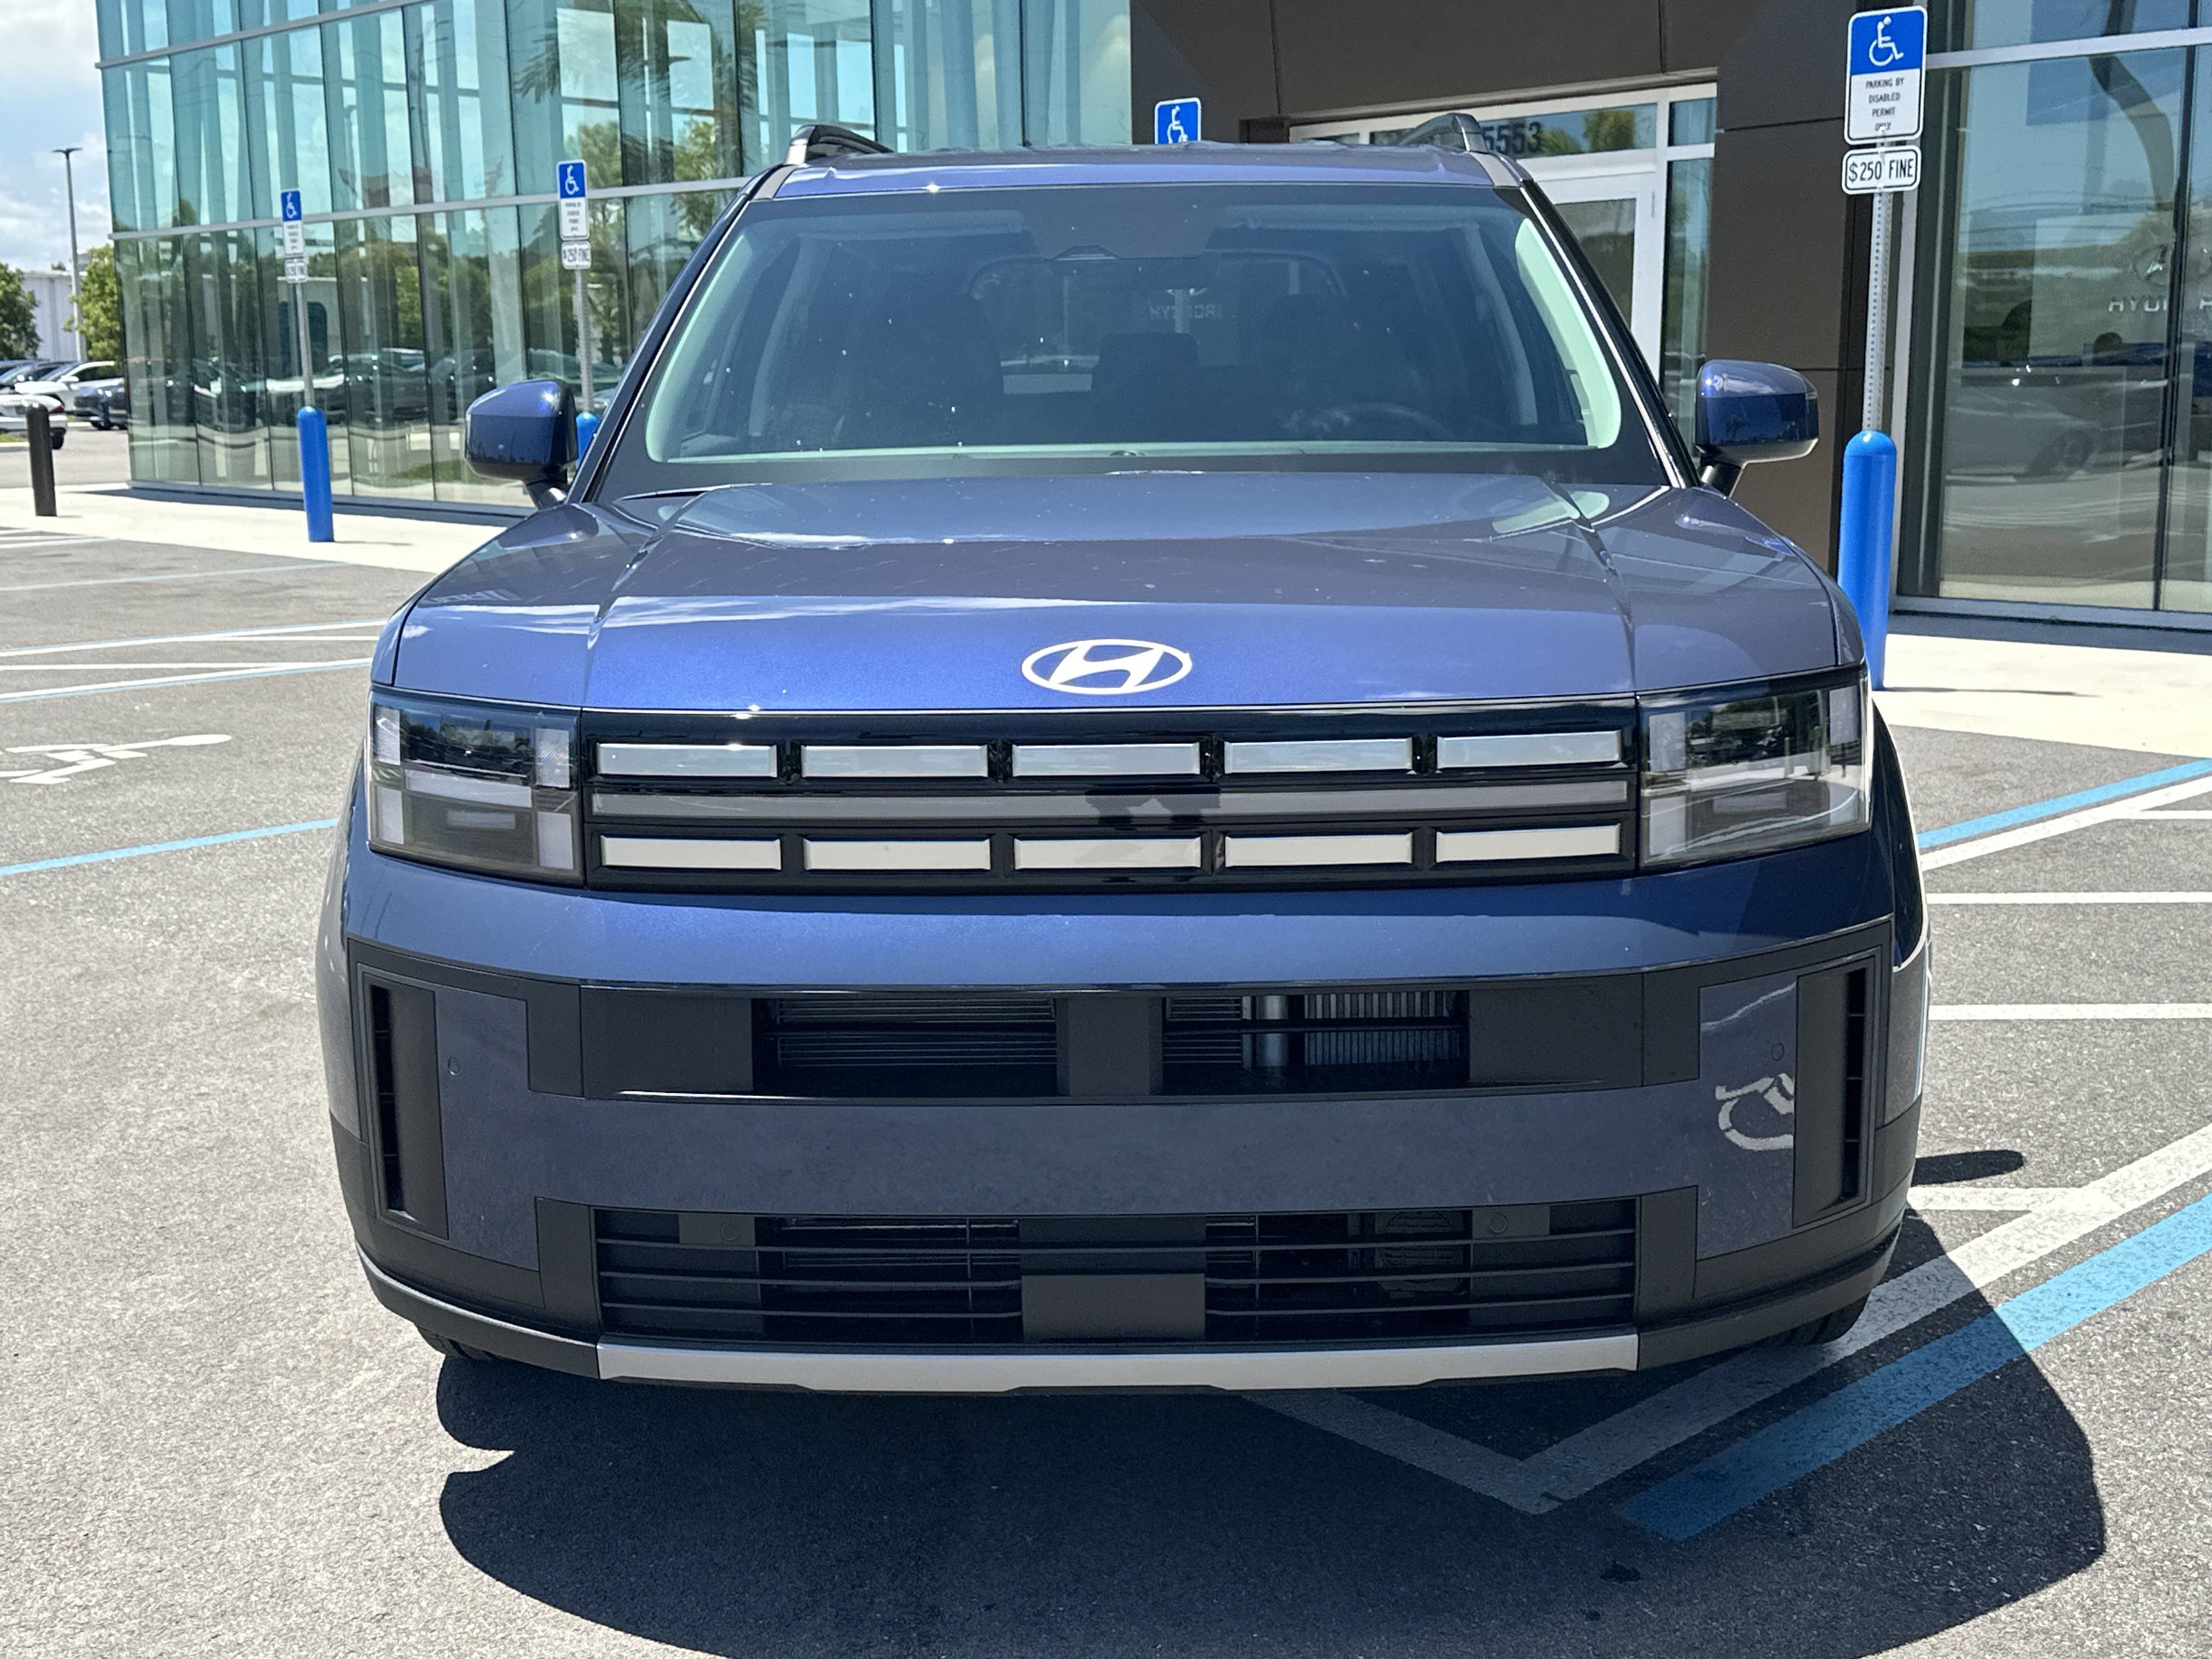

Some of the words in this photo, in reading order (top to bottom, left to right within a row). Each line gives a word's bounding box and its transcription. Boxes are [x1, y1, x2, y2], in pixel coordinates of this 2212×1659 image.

[1865, 78, 1893, 89] PARKING
[1895, 77, 1904, 86] BY
[1869, 92, 1900, 104] DISABLED
[1872, 106, 1895, 117] PERMIT
[1849, 161, 1882, 182] $250
[1889, 159, 1914, 179] FINE
